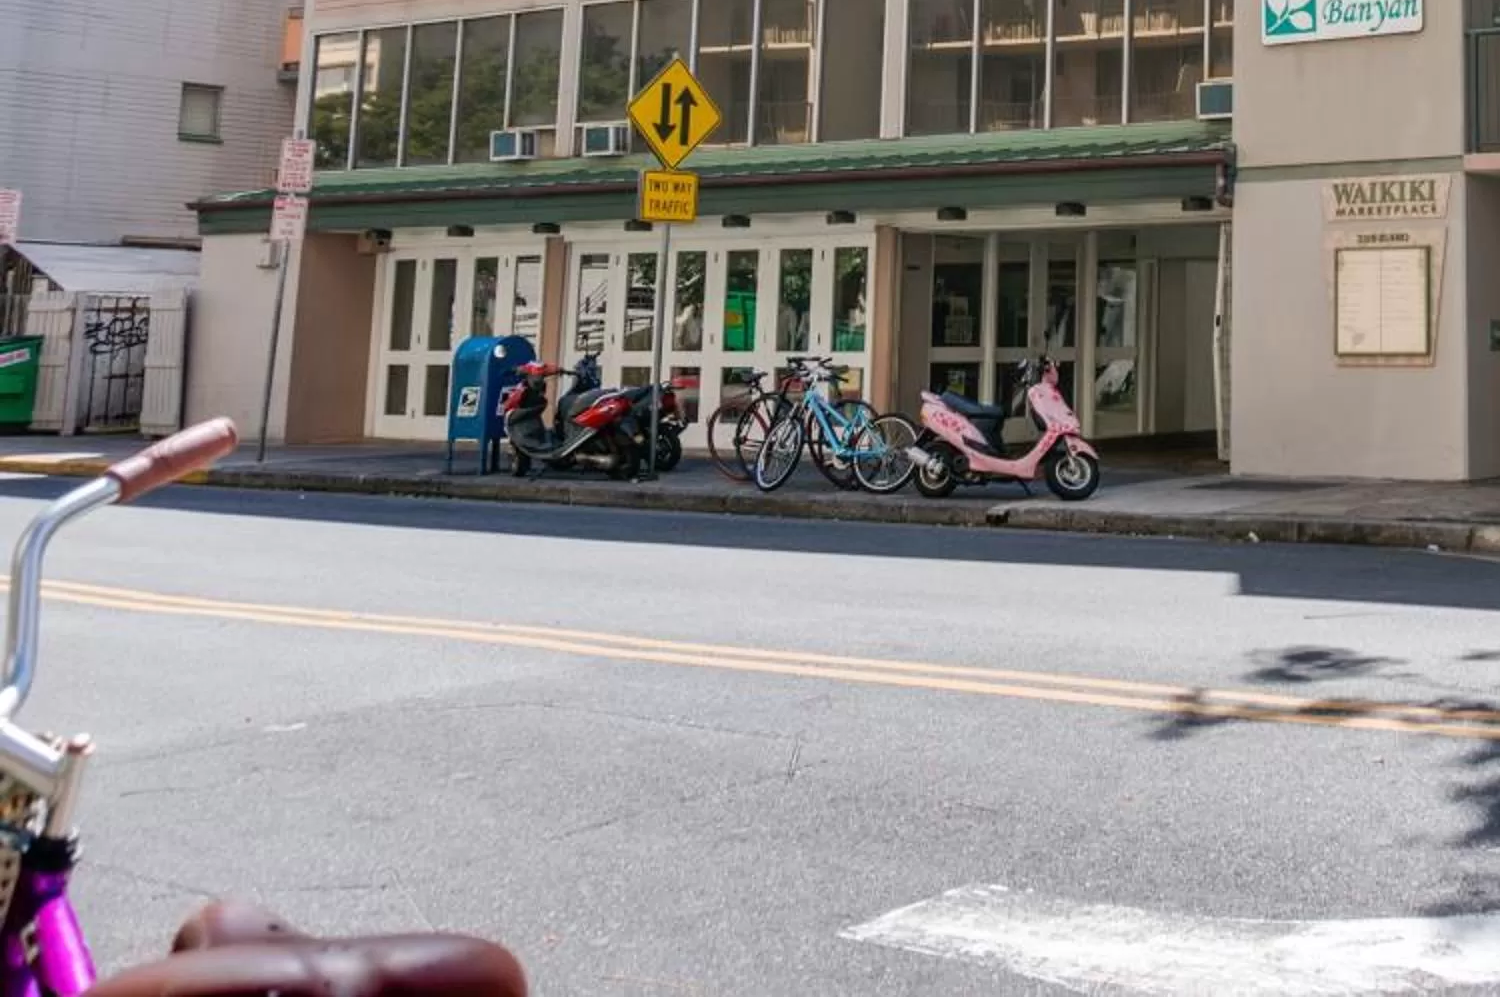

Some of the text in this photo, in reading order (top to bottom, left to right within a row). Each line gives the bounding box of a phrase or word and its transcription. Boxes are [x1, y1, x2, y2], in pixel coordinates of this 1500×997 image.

[649, 178, 692, 193] TWO WAY
[1332, 179, 1436, 206] WAIKIKI
[648, 200, 690, 215] TRAFFIC
[1335, 204, 1437, 217] MARKETPLACE
